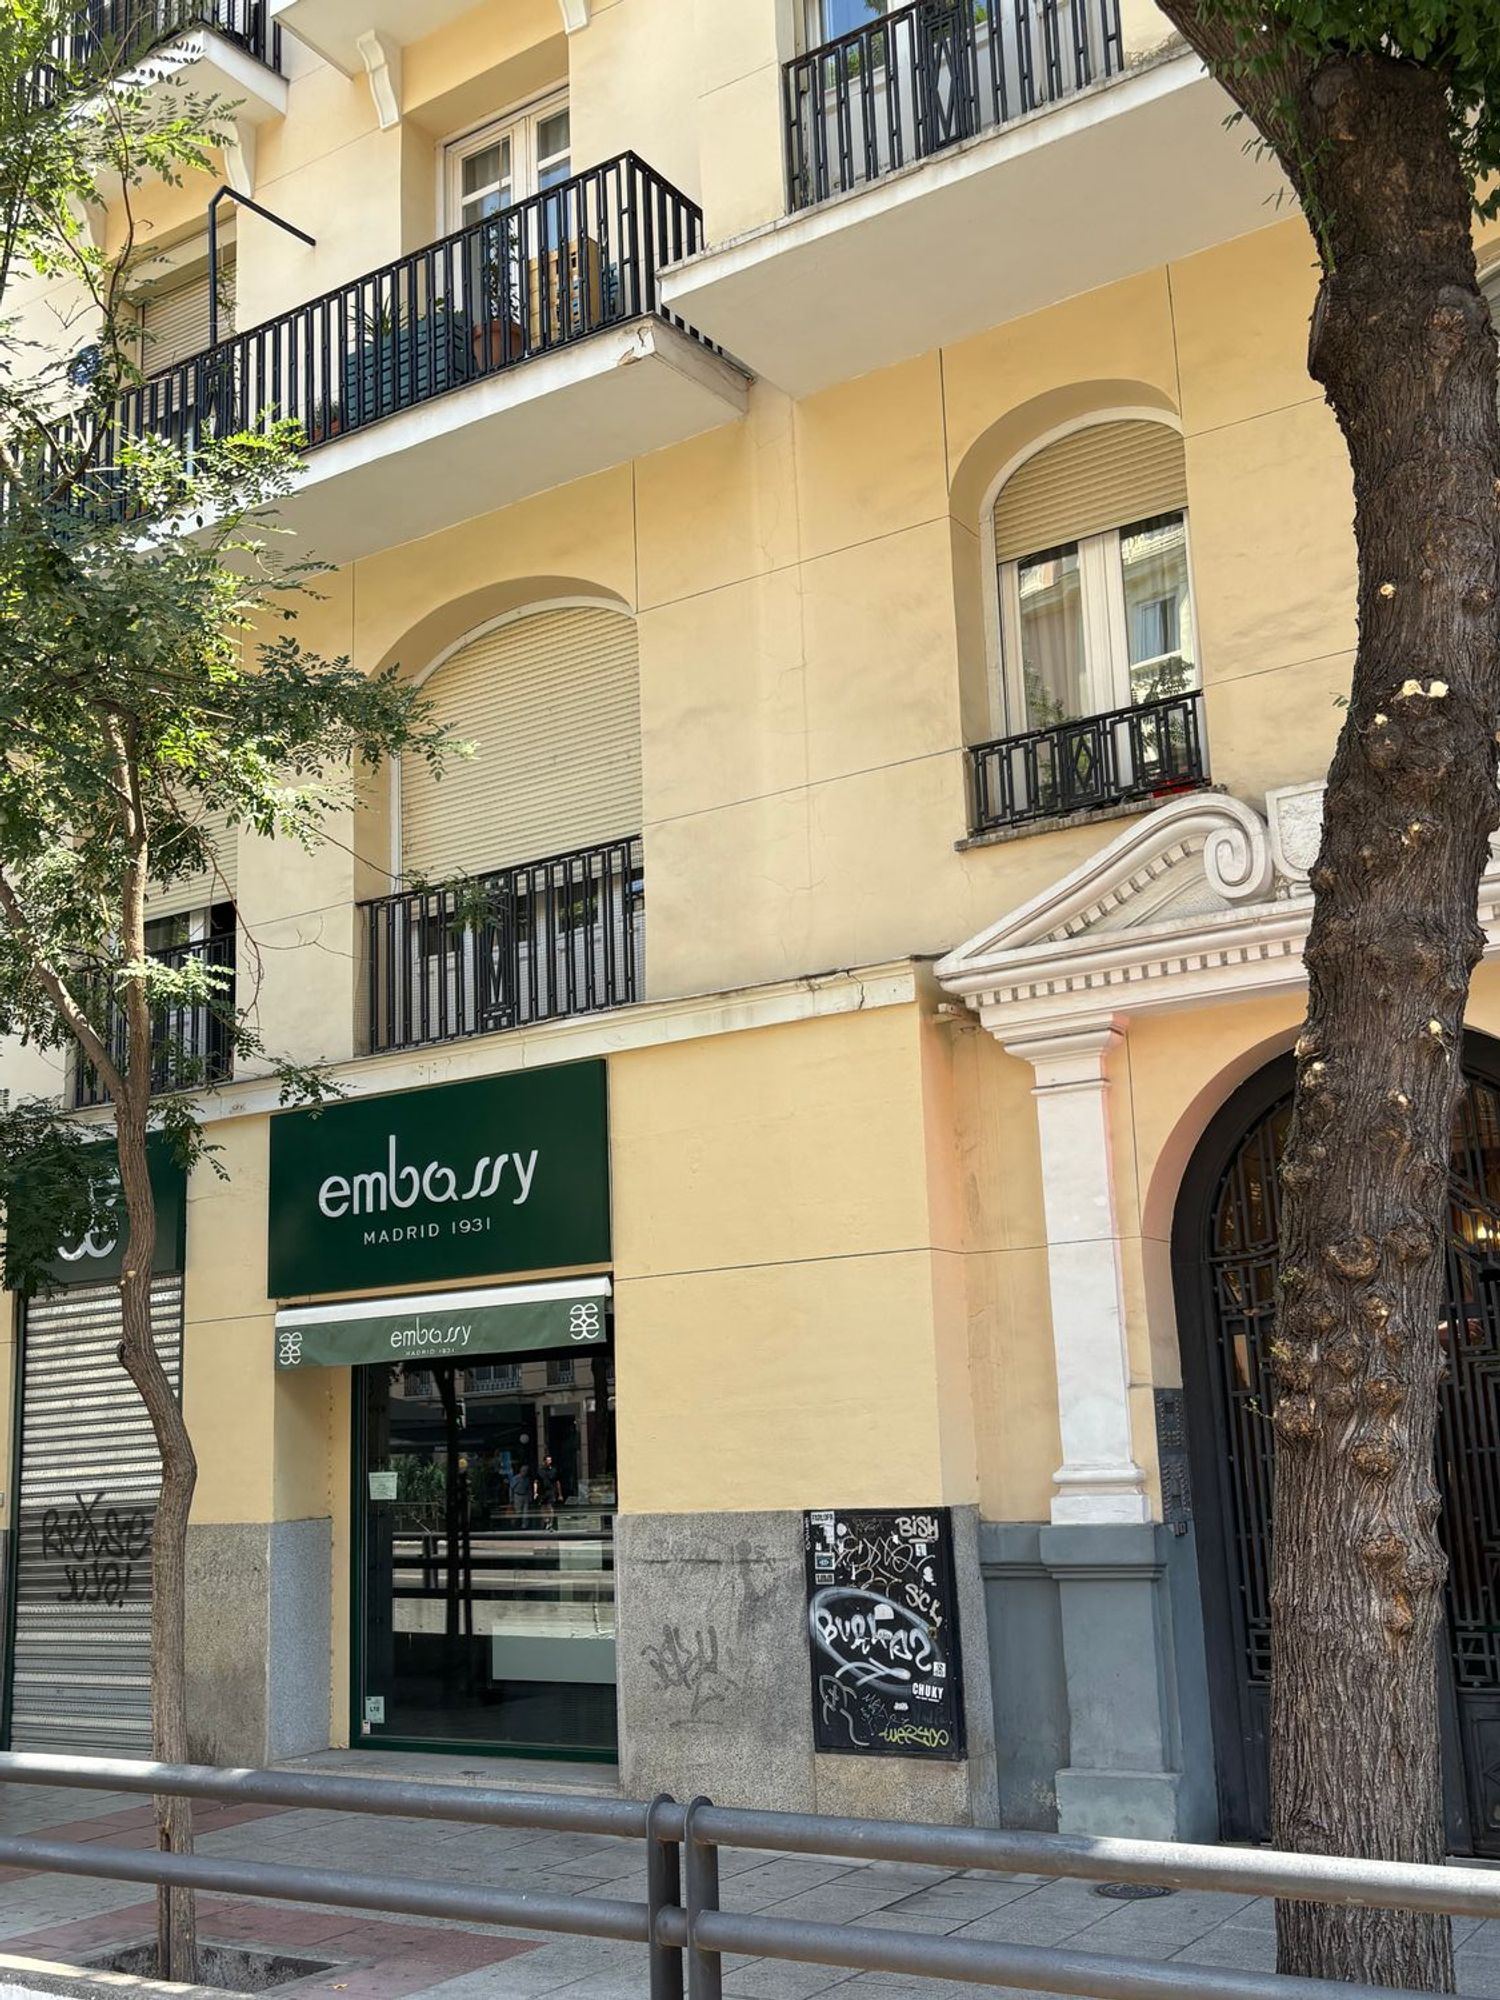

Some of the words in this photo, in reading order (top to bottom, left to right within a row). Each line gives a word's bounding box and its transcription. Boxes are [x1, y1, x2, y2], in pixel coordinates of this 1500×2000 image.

[318, 1134, 539, 1218] embassy
[363, 1223, 440, 1246] MADRID
[451, 1216, 491, 1235] 1931
[390, 1316, 472, 1348] embassy
[405, 1348, 436, 1356] MADRID
[912, 1682, 944, 1700] CHUKY
